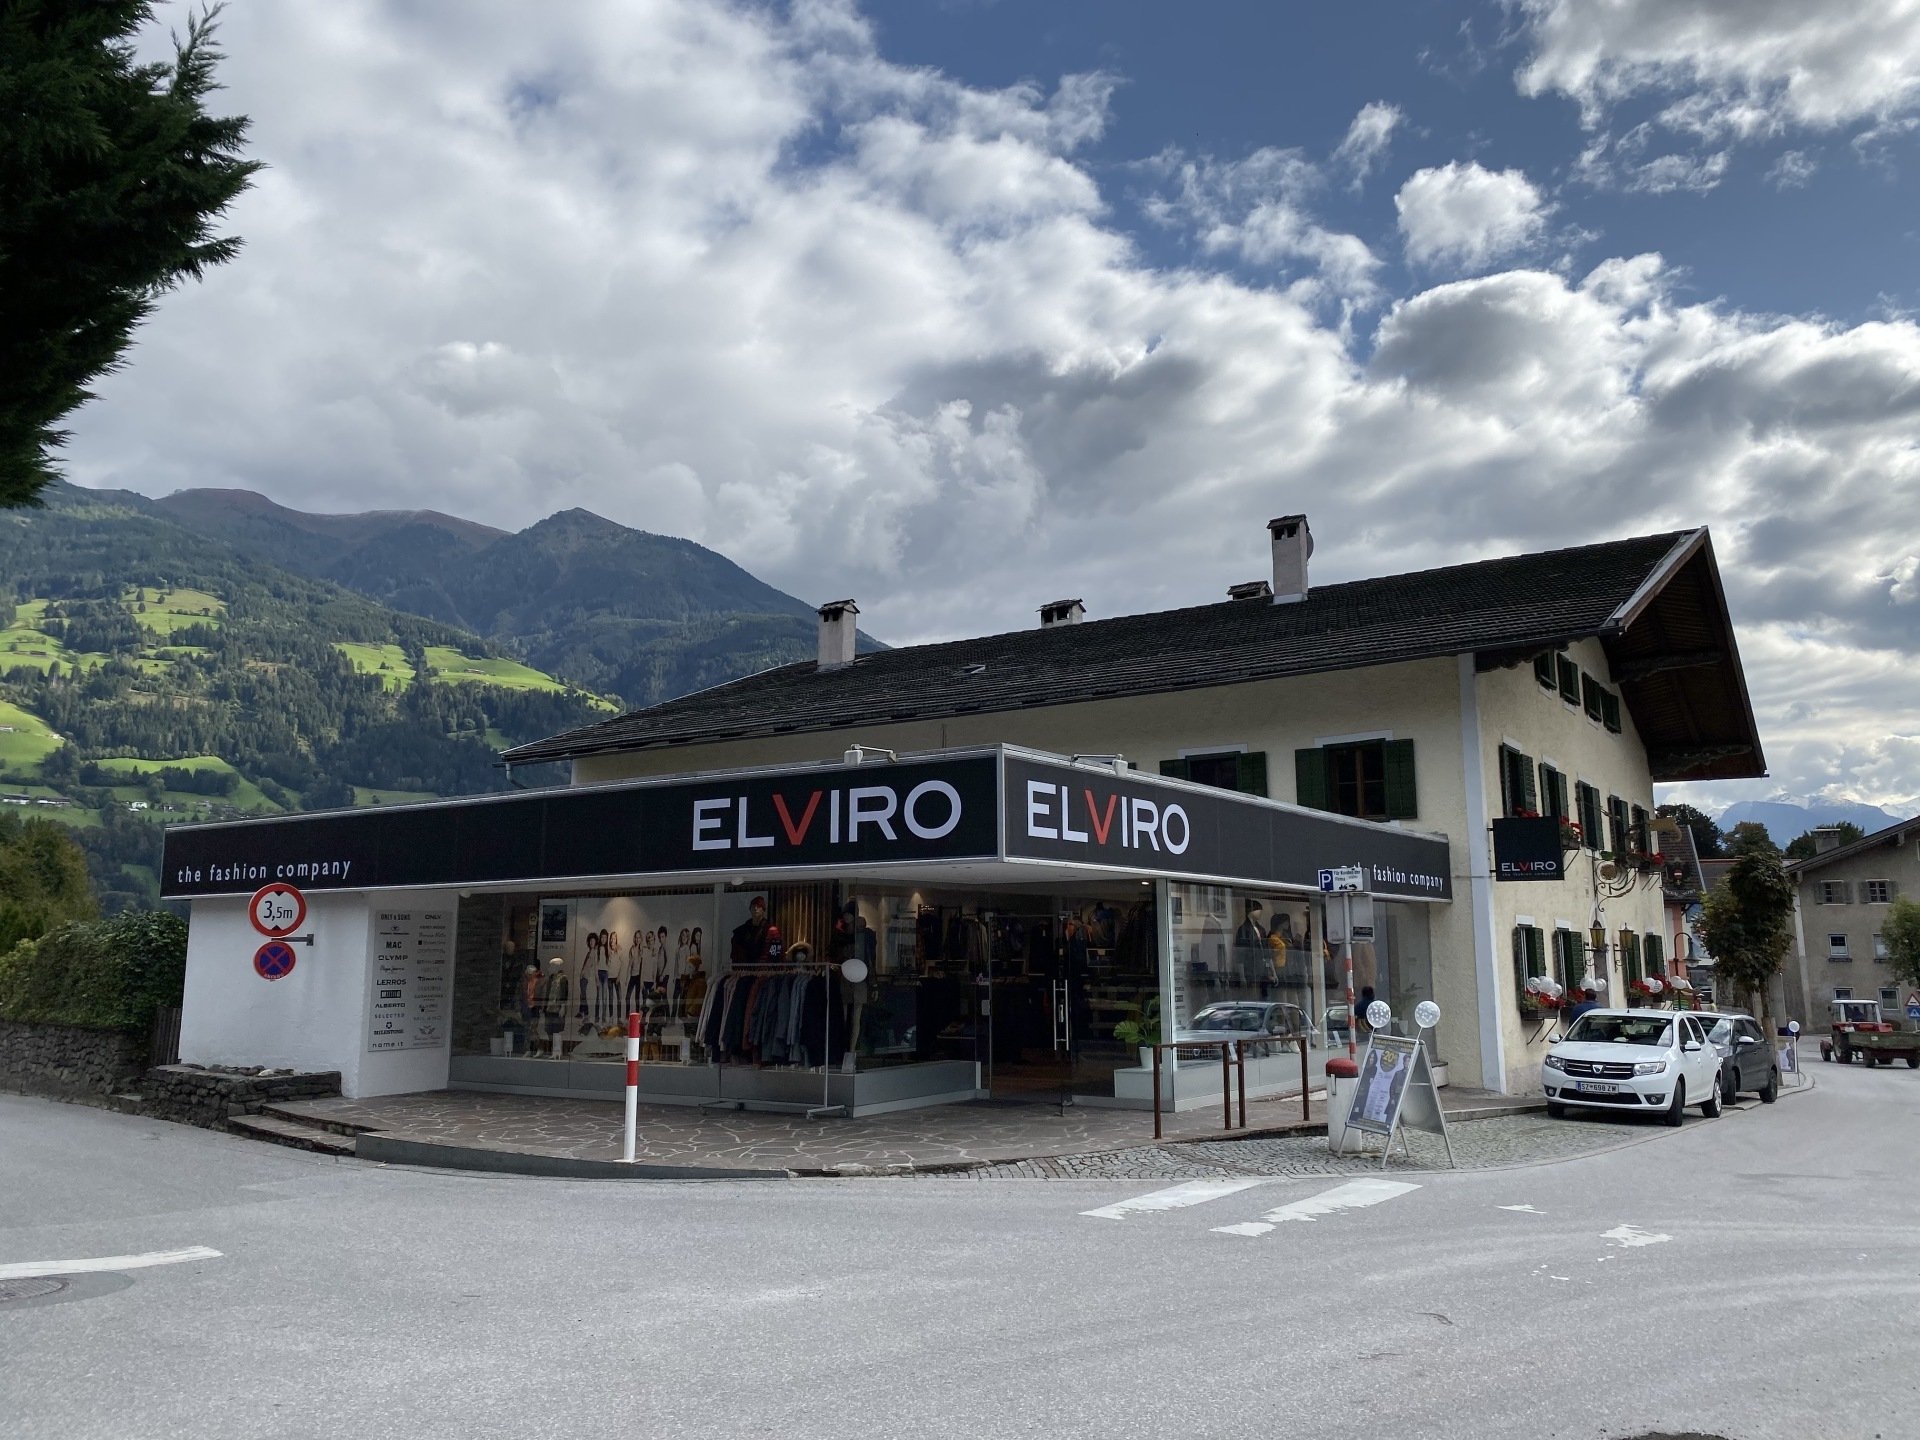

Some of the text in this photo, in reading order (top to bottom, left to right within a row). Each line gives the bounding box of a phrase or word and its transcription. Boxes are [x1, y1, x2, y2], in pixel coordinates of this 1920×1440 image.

[692, 780, 962, 851] ELVIRO
[1027, 780, 1190, 855] ELVIRO
[177, 860, 351, 884] the fashion company
[1501, 861, 1557, 872] ELVIRO
[1321, 873, 1332, 889] P
[1373, 863, 1444, 892] fashion company
[263, 900, 293, 921] 3,5m
[386, 941, 402, 949] MAC
[376, 978, 407, 986] LERROS
